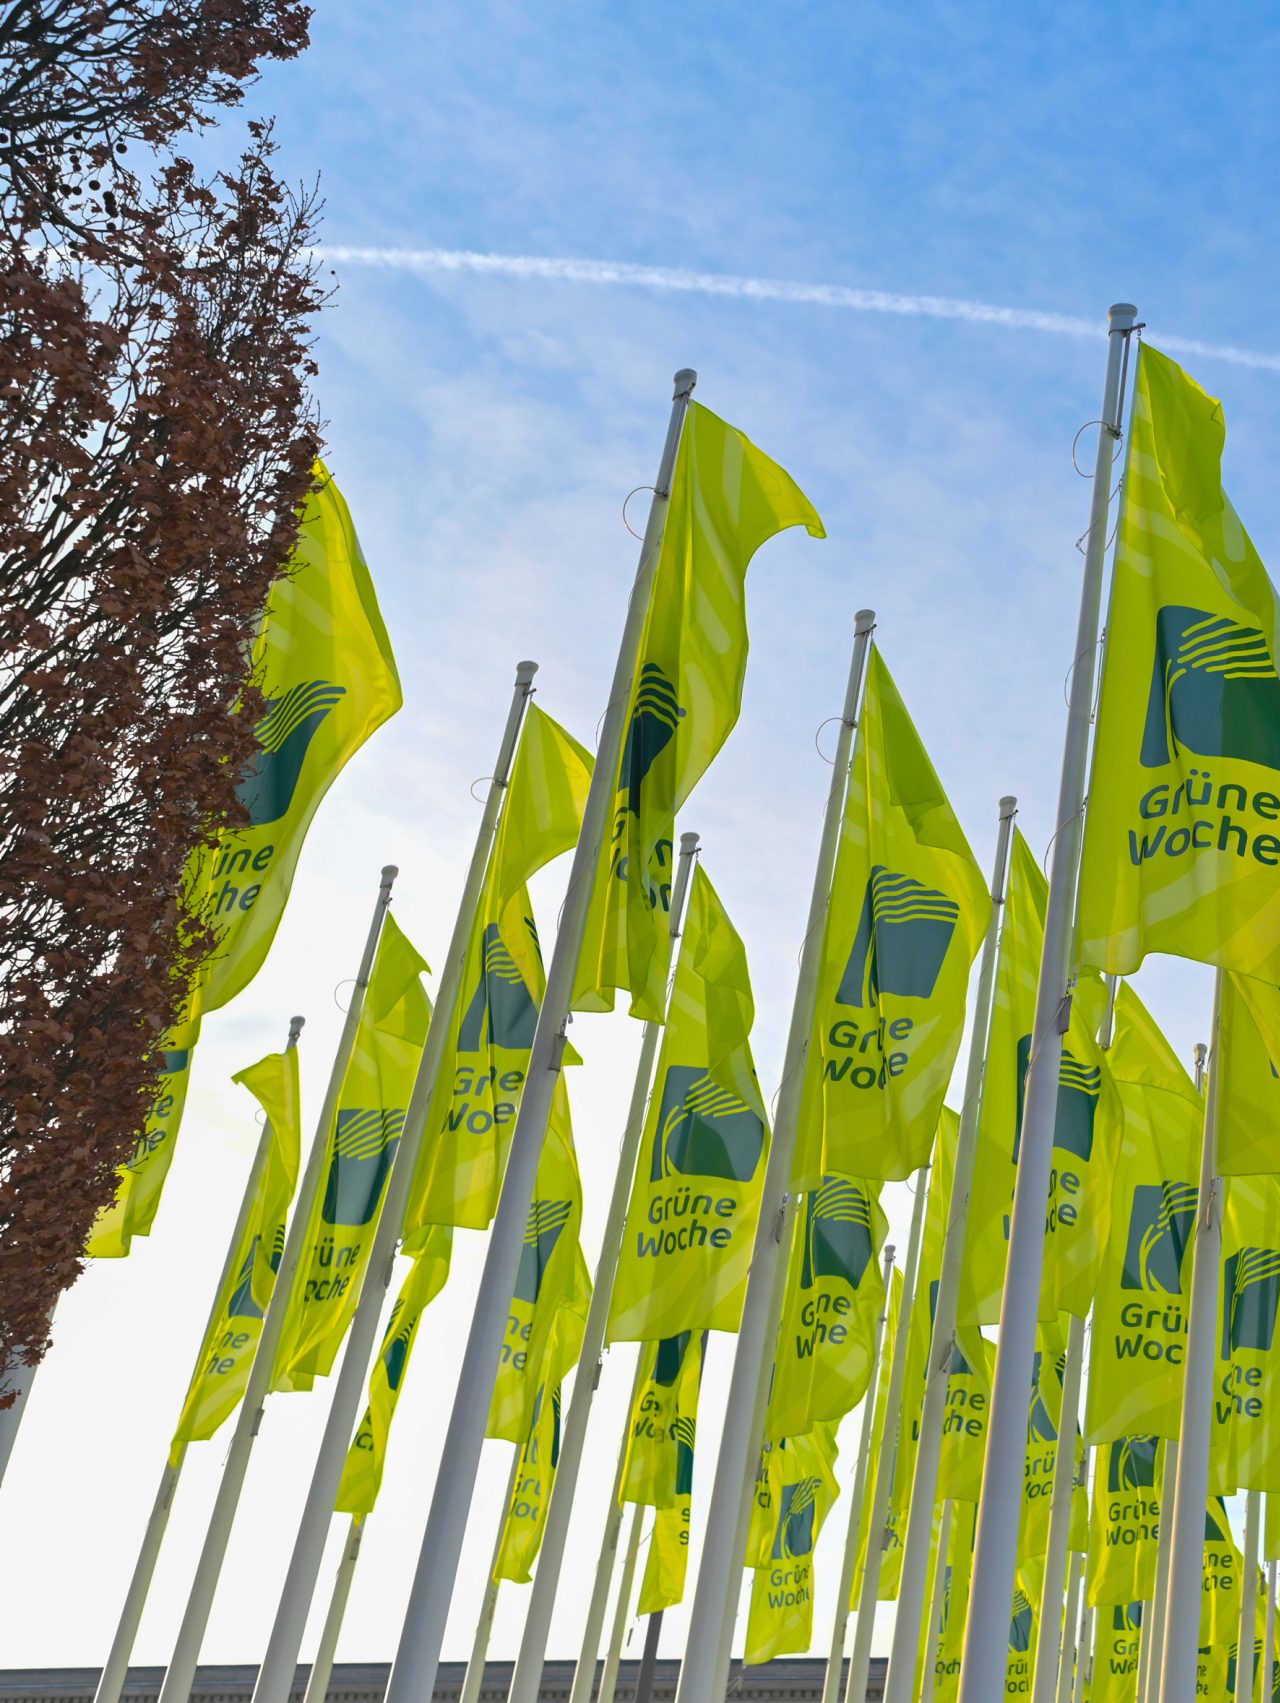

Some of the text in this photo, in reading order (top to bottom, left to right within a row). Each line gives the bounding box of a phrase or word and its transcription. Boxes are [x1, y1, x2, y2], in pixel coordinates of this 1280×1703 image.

[648, 1187, 737, 1225] Grüne
[637, 1219, 732, 1258] Woche
[801, 1293, 851, 1328] Gne
[1121, 1303, 1189, 1335] Grü
[796, 1318, 848, 1360] Whe
[1115, 1333, 1184, 1365] Woc
